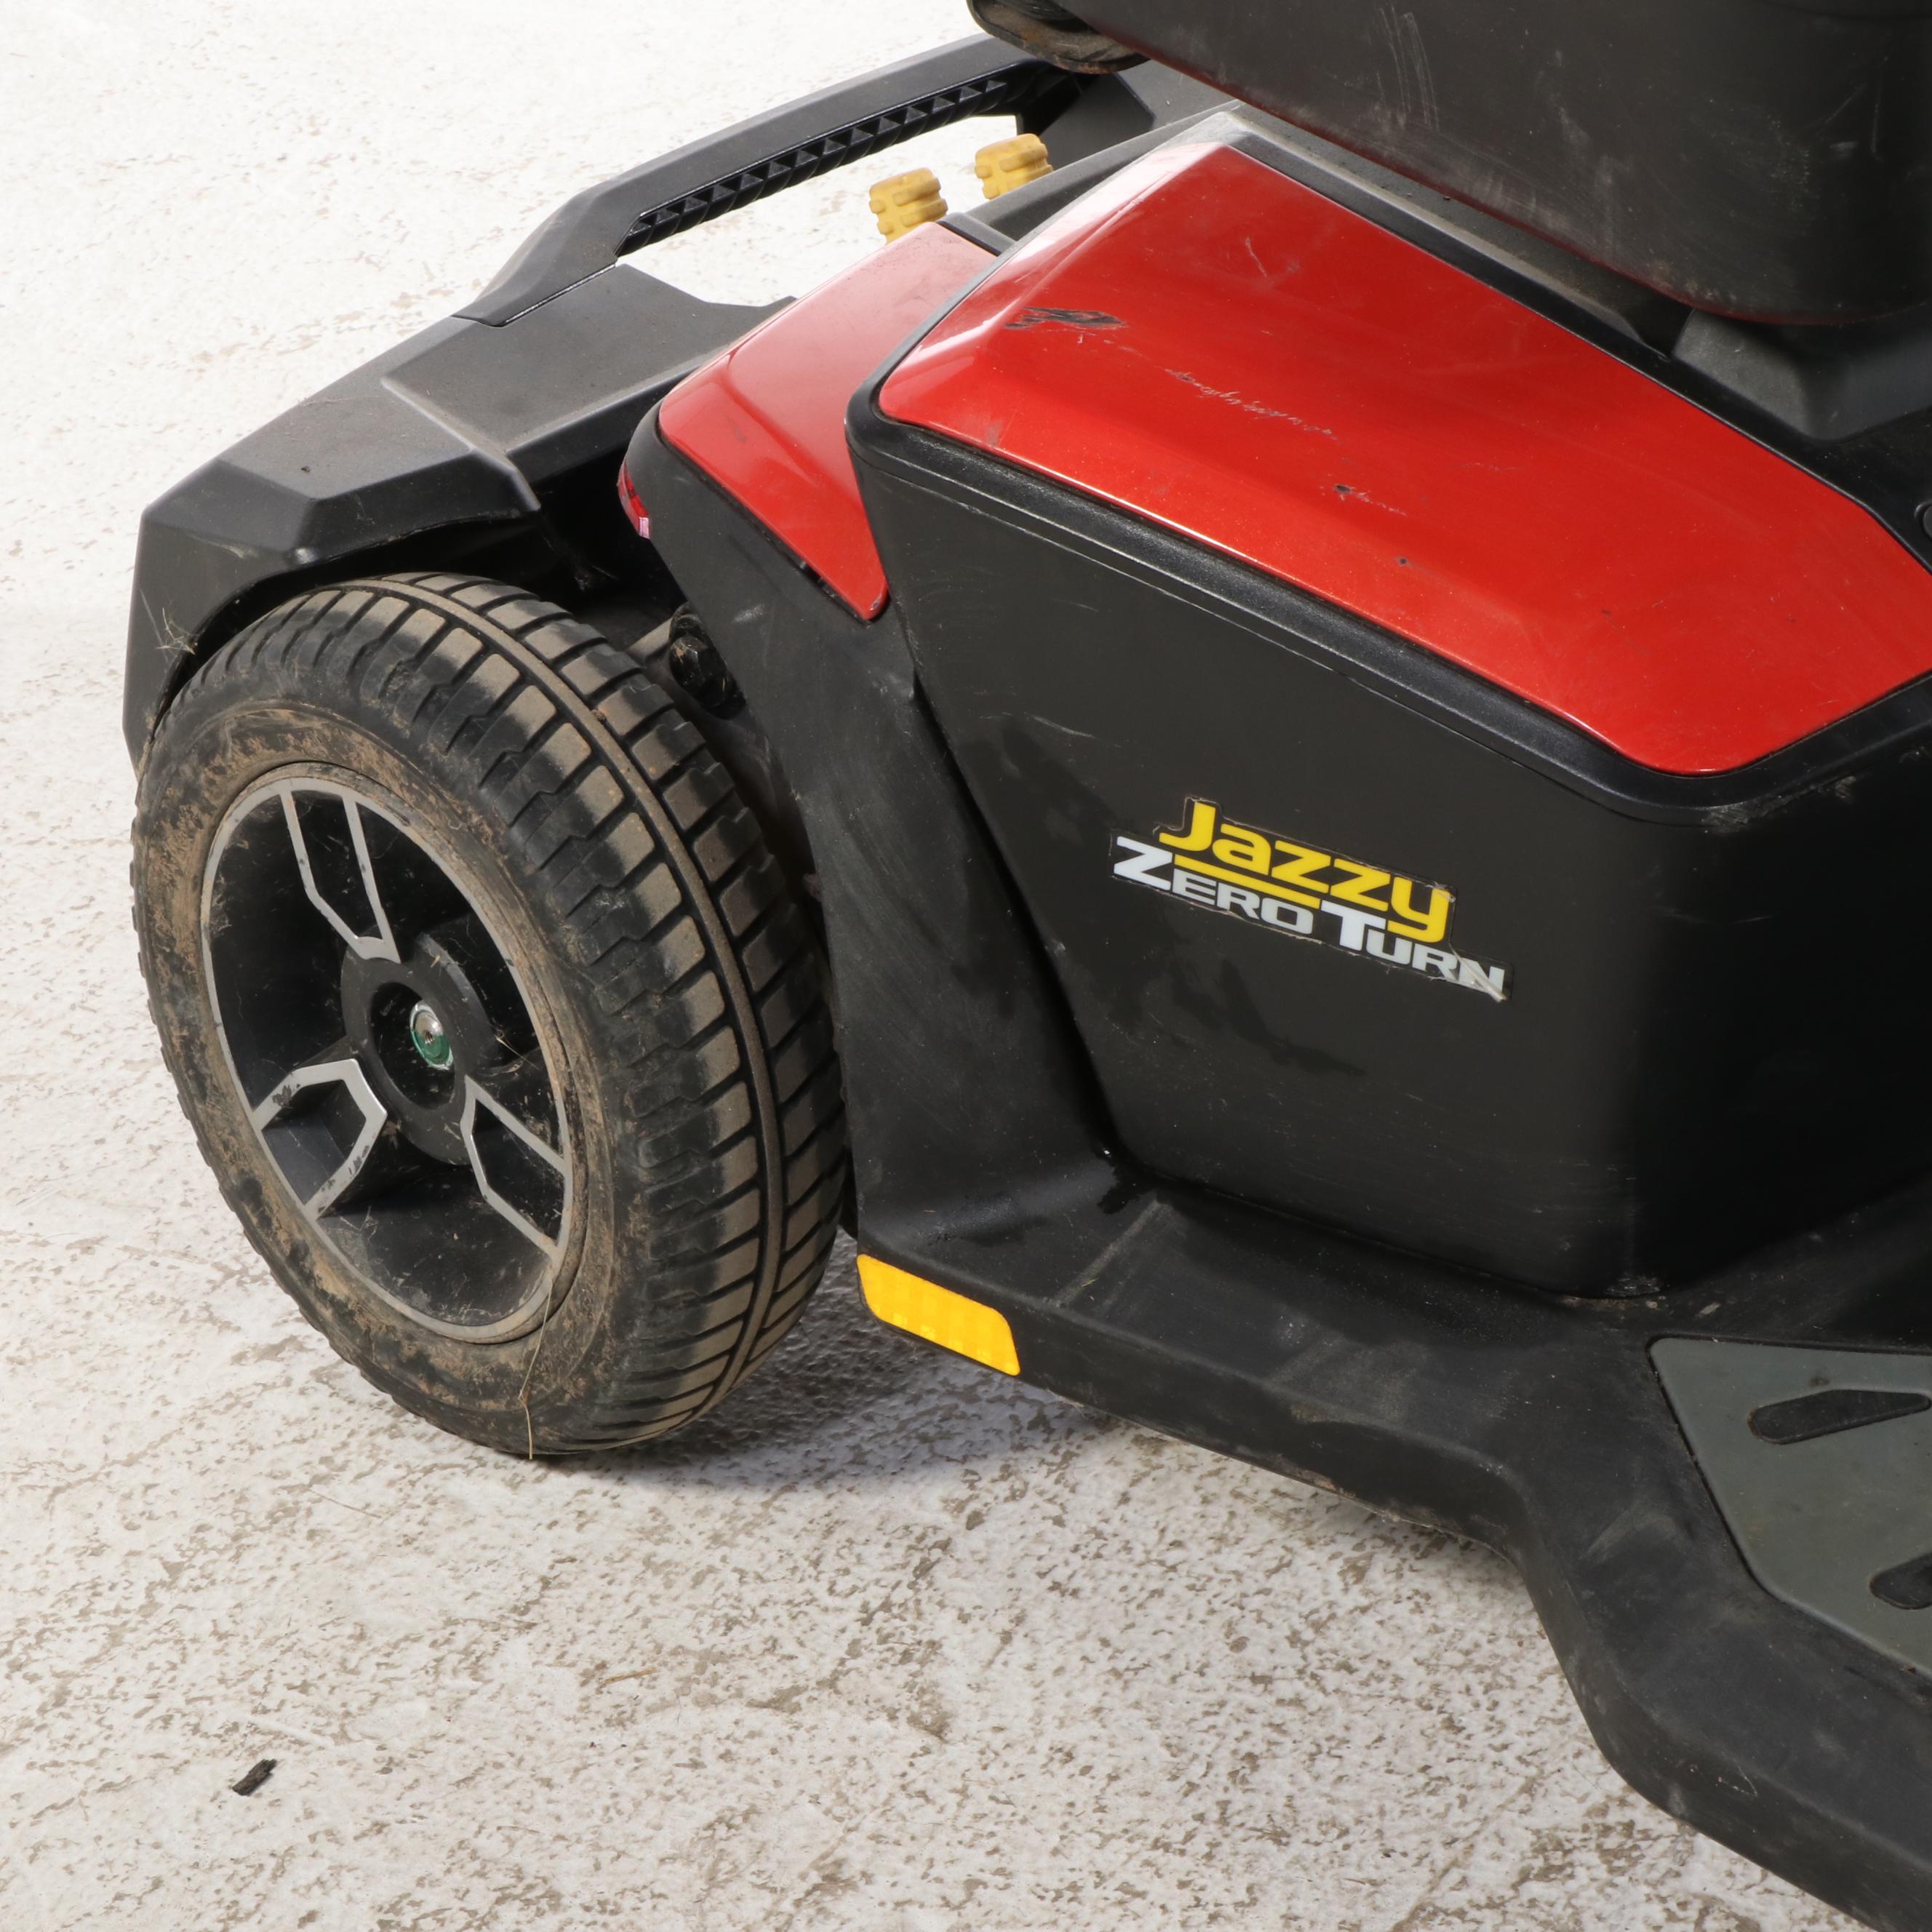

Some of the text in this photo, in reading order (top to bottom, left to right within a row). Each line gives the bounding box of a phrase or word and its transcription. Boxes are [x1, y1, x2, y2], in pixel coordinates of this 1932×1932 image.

[1114, 836, 1506, 997] ZERO TURN
[1159, 801, 1450, 943] Jazzy
